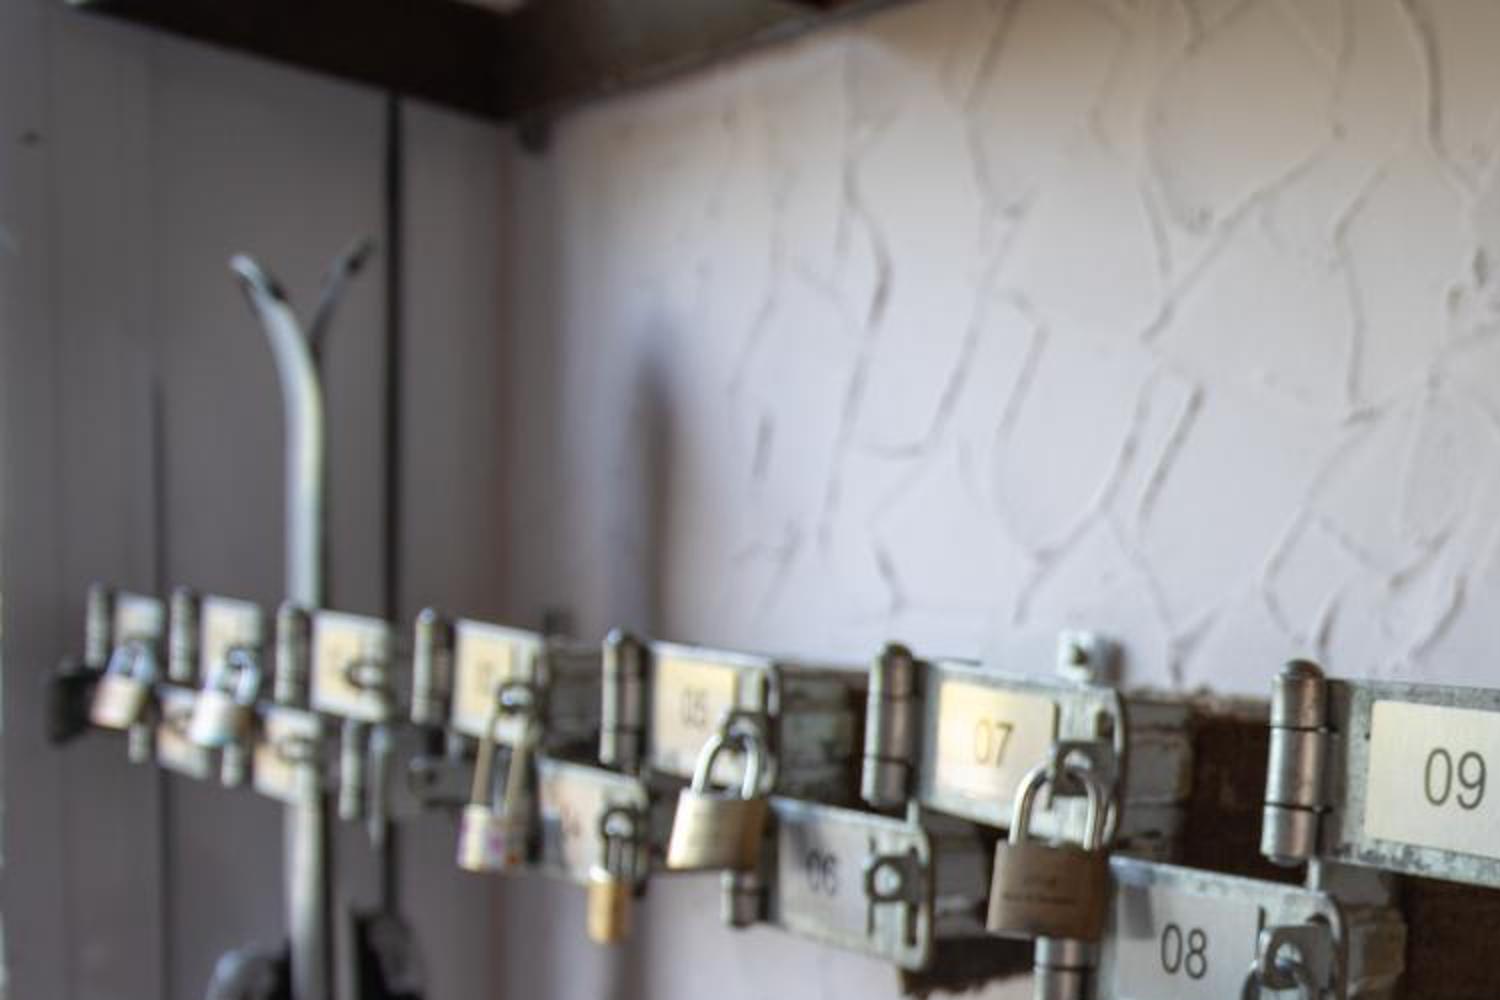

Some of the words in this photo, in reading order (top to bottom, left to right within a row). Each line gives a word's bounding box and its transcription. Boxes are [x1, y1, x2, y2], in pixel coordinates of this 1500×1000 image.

[975, 718, 1014, 767] 07
[1424, 747, 1487, 811] 09
[805, 849, 839, 896] 06
[1161, 922, 1208, 980] 08
